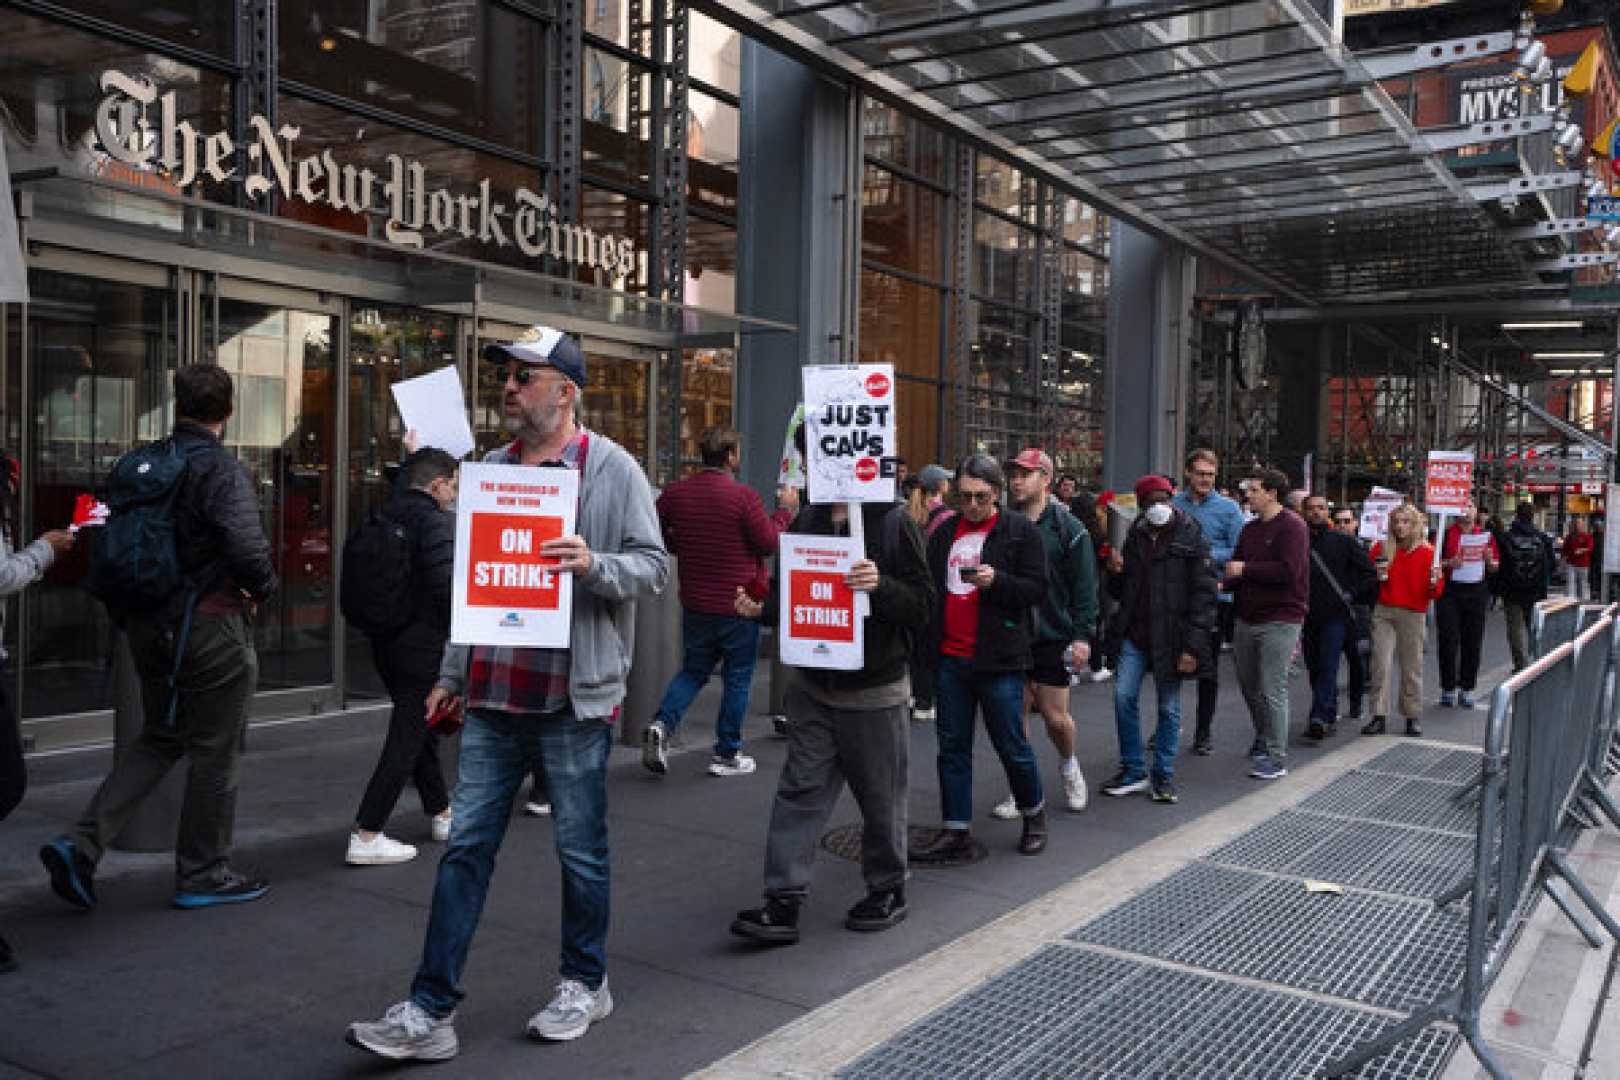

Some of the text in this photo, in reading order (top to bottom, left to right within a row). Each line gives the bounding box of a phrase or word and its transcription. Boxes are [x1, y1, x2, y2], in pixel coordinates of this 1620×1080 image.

[97, 69, 635, 277] The New York Times
[820, 404, 889, 427] JUST
[501, 528, 533, 554] ON
[474, 561, 555, 590] STRIKE
[810, 581, 833, 600] ON
[793, 605, 849, 627] STRIKE
